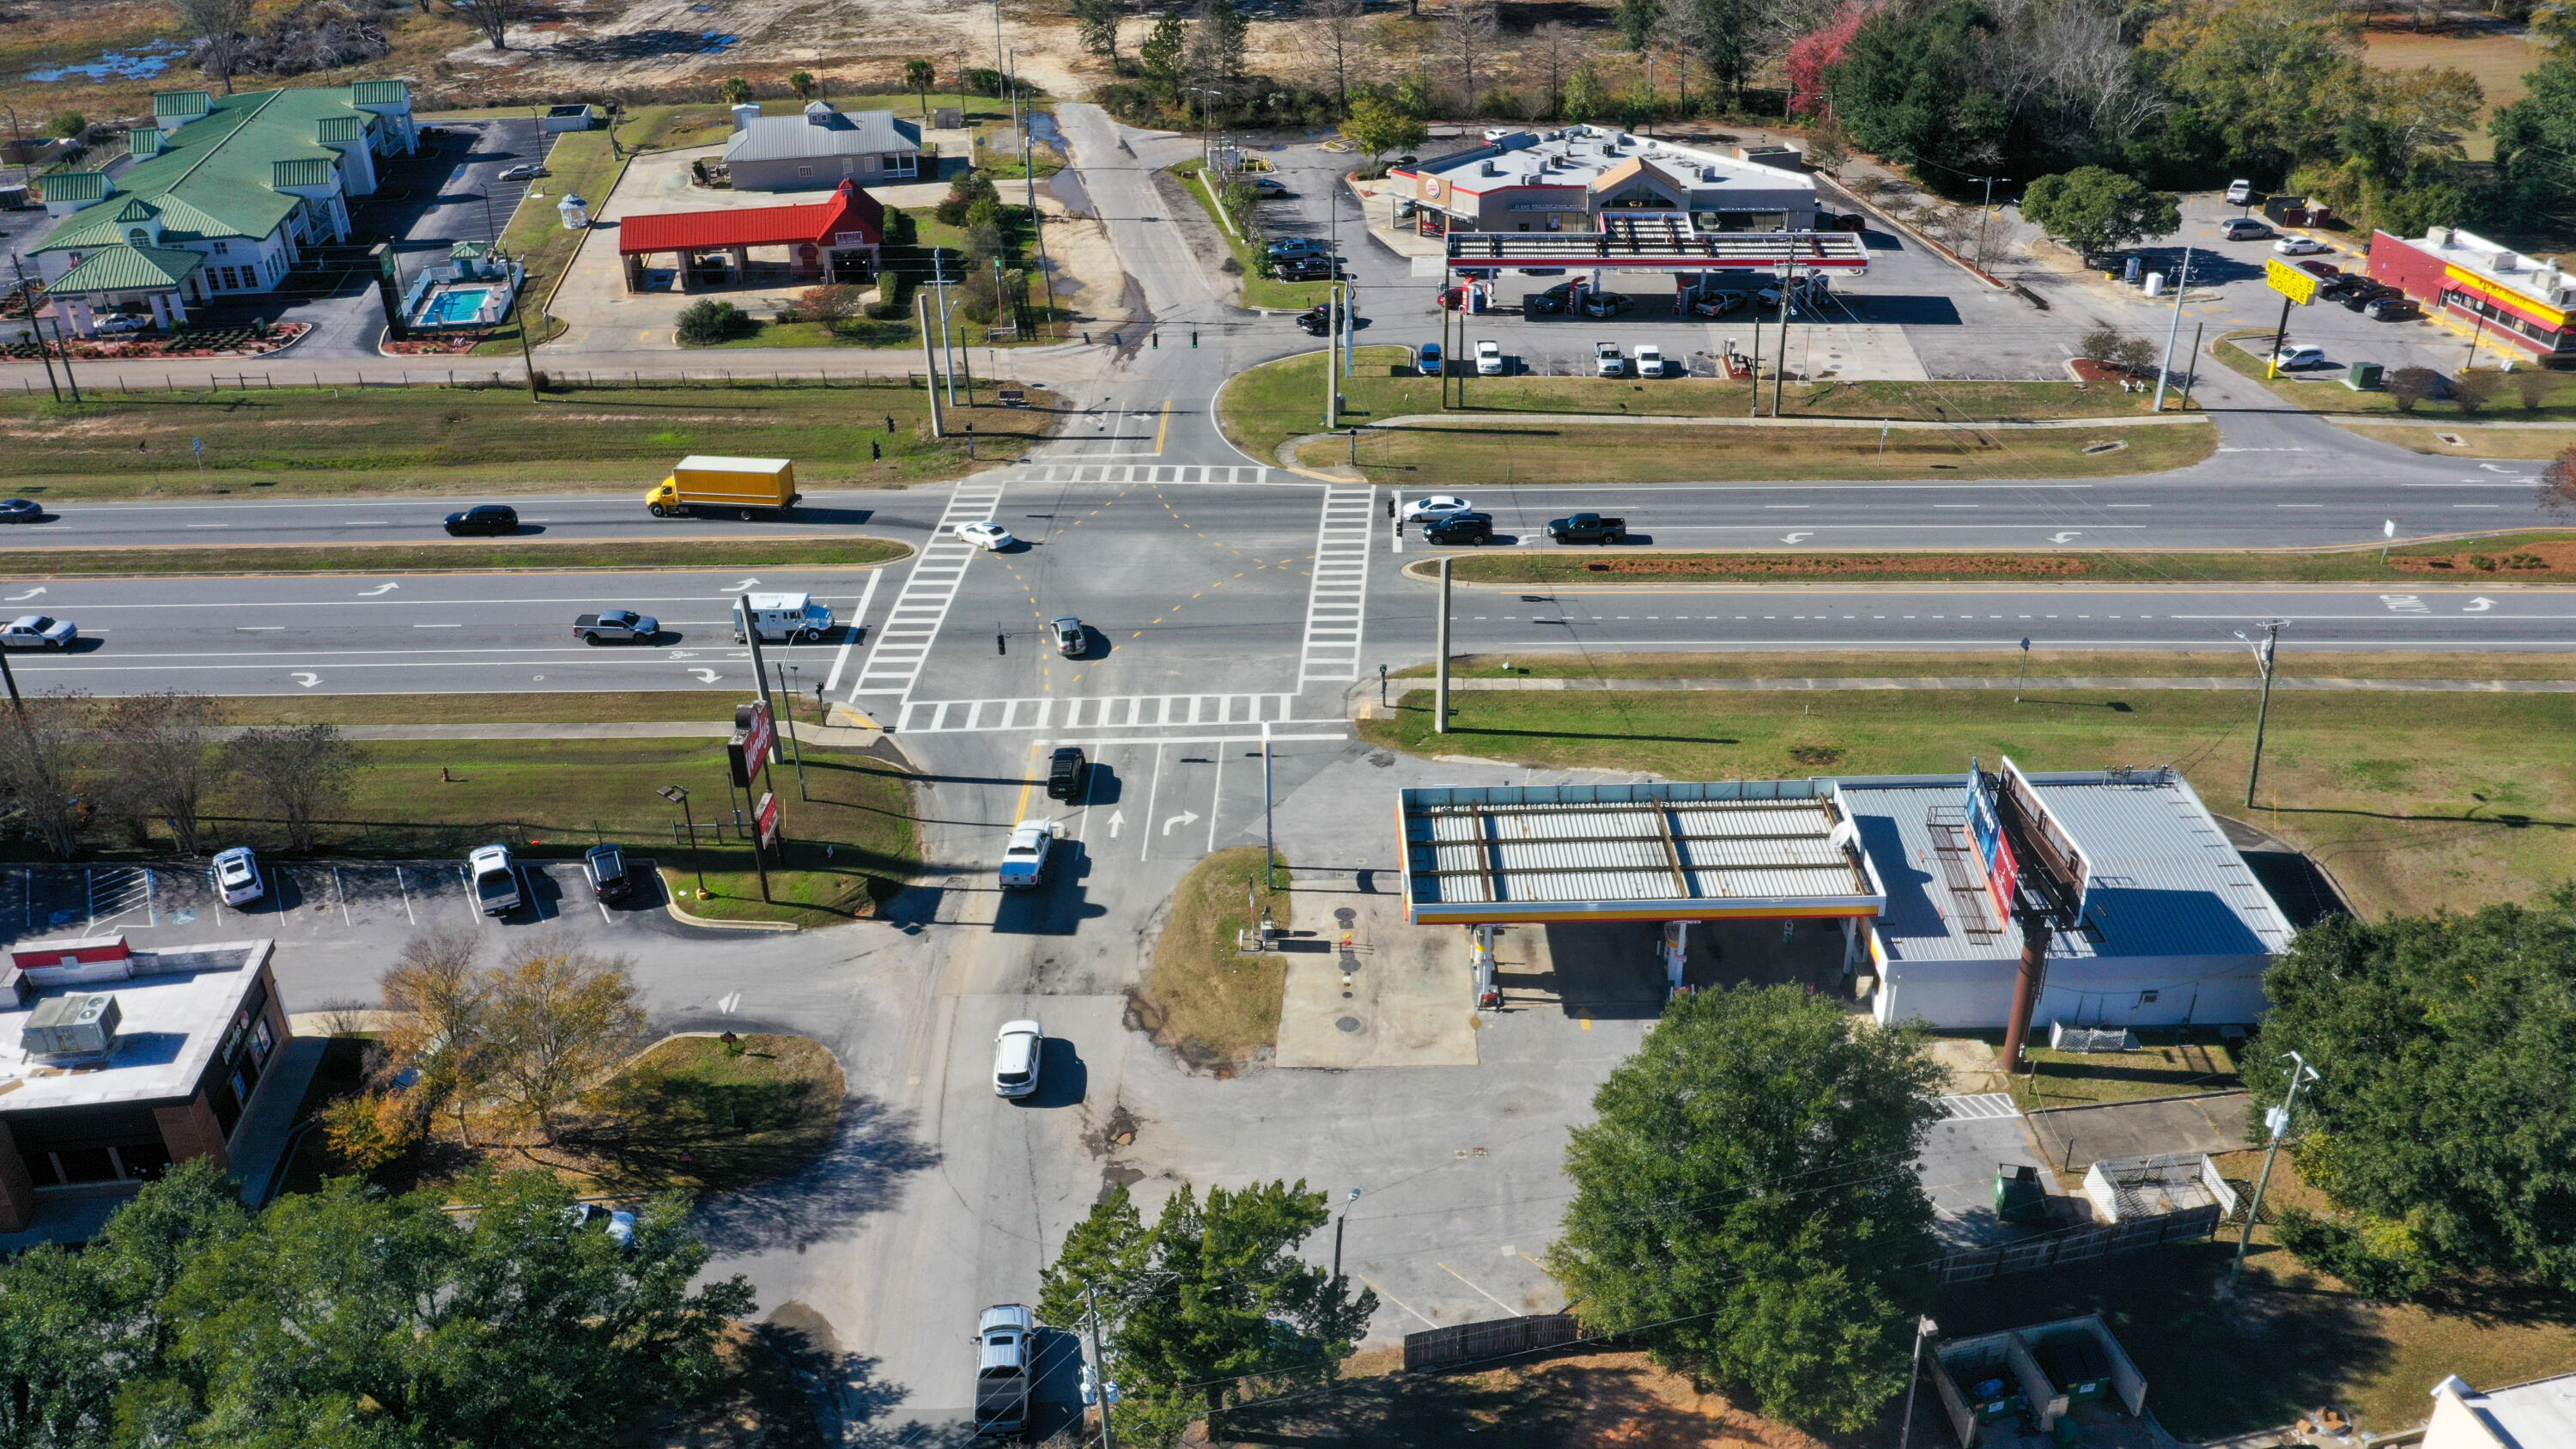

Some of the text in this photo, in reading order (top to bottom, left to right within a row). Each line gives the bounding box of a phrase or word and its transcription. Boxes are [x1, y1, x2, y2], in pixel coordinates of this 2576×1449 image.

[2268, 260, 2312, 291] WAFFLE
[2269, 276, 2306, 302] HOUSE
[2379, 594, 2433, 613] ONLY
[745, 716, 770, 778] Wendy's
[1976, 786, 1996, 834] ARIAT
